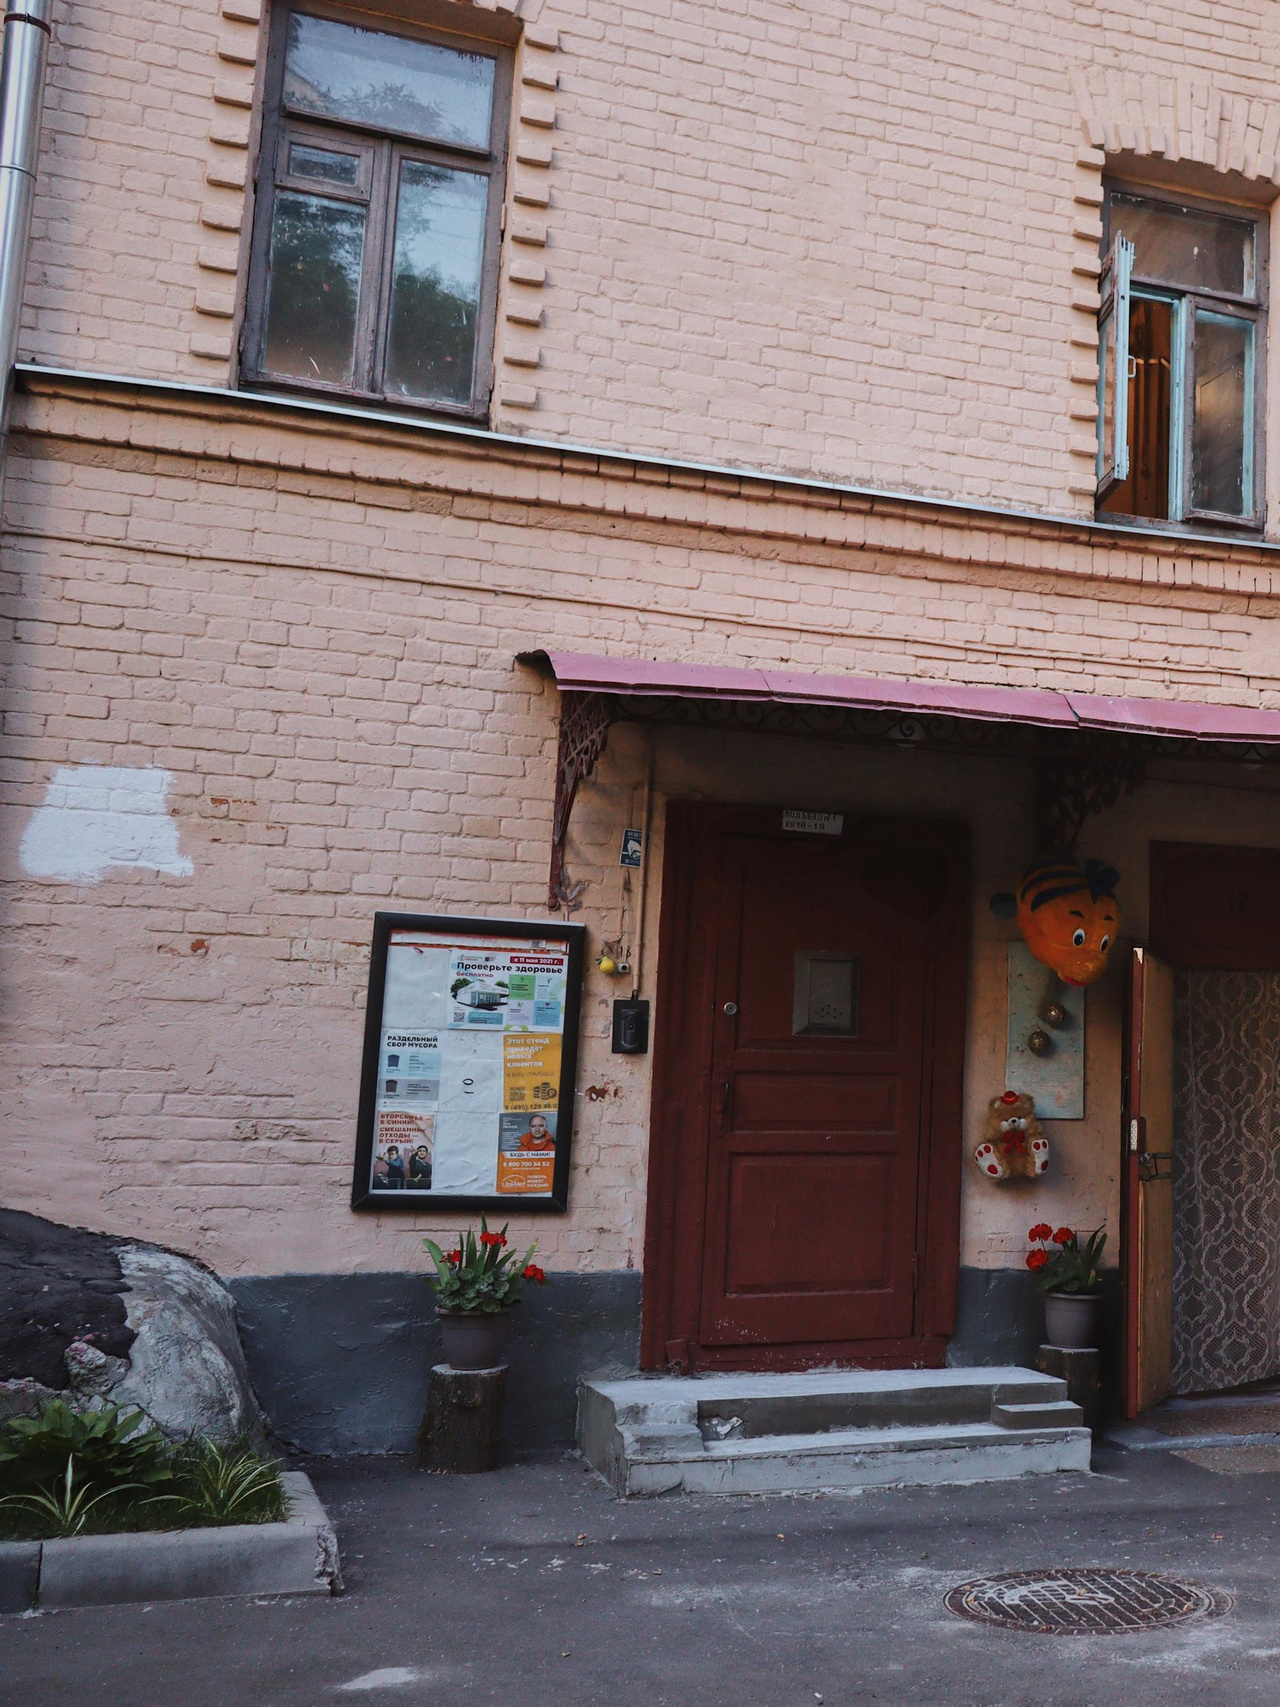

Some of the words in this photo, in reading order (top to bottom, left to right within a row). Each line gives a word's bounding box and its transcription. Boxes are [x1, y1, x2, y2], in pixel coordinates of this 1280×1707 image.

[456, 962, 513, 972] Проверьте
[515, 965, 563, 975] здоровье
[387, 1035, 438, 1043] РАЗДЕЛЬНЫЙ
[380, 1113, 424, 1121] ВТОРСЫРЬЕ
